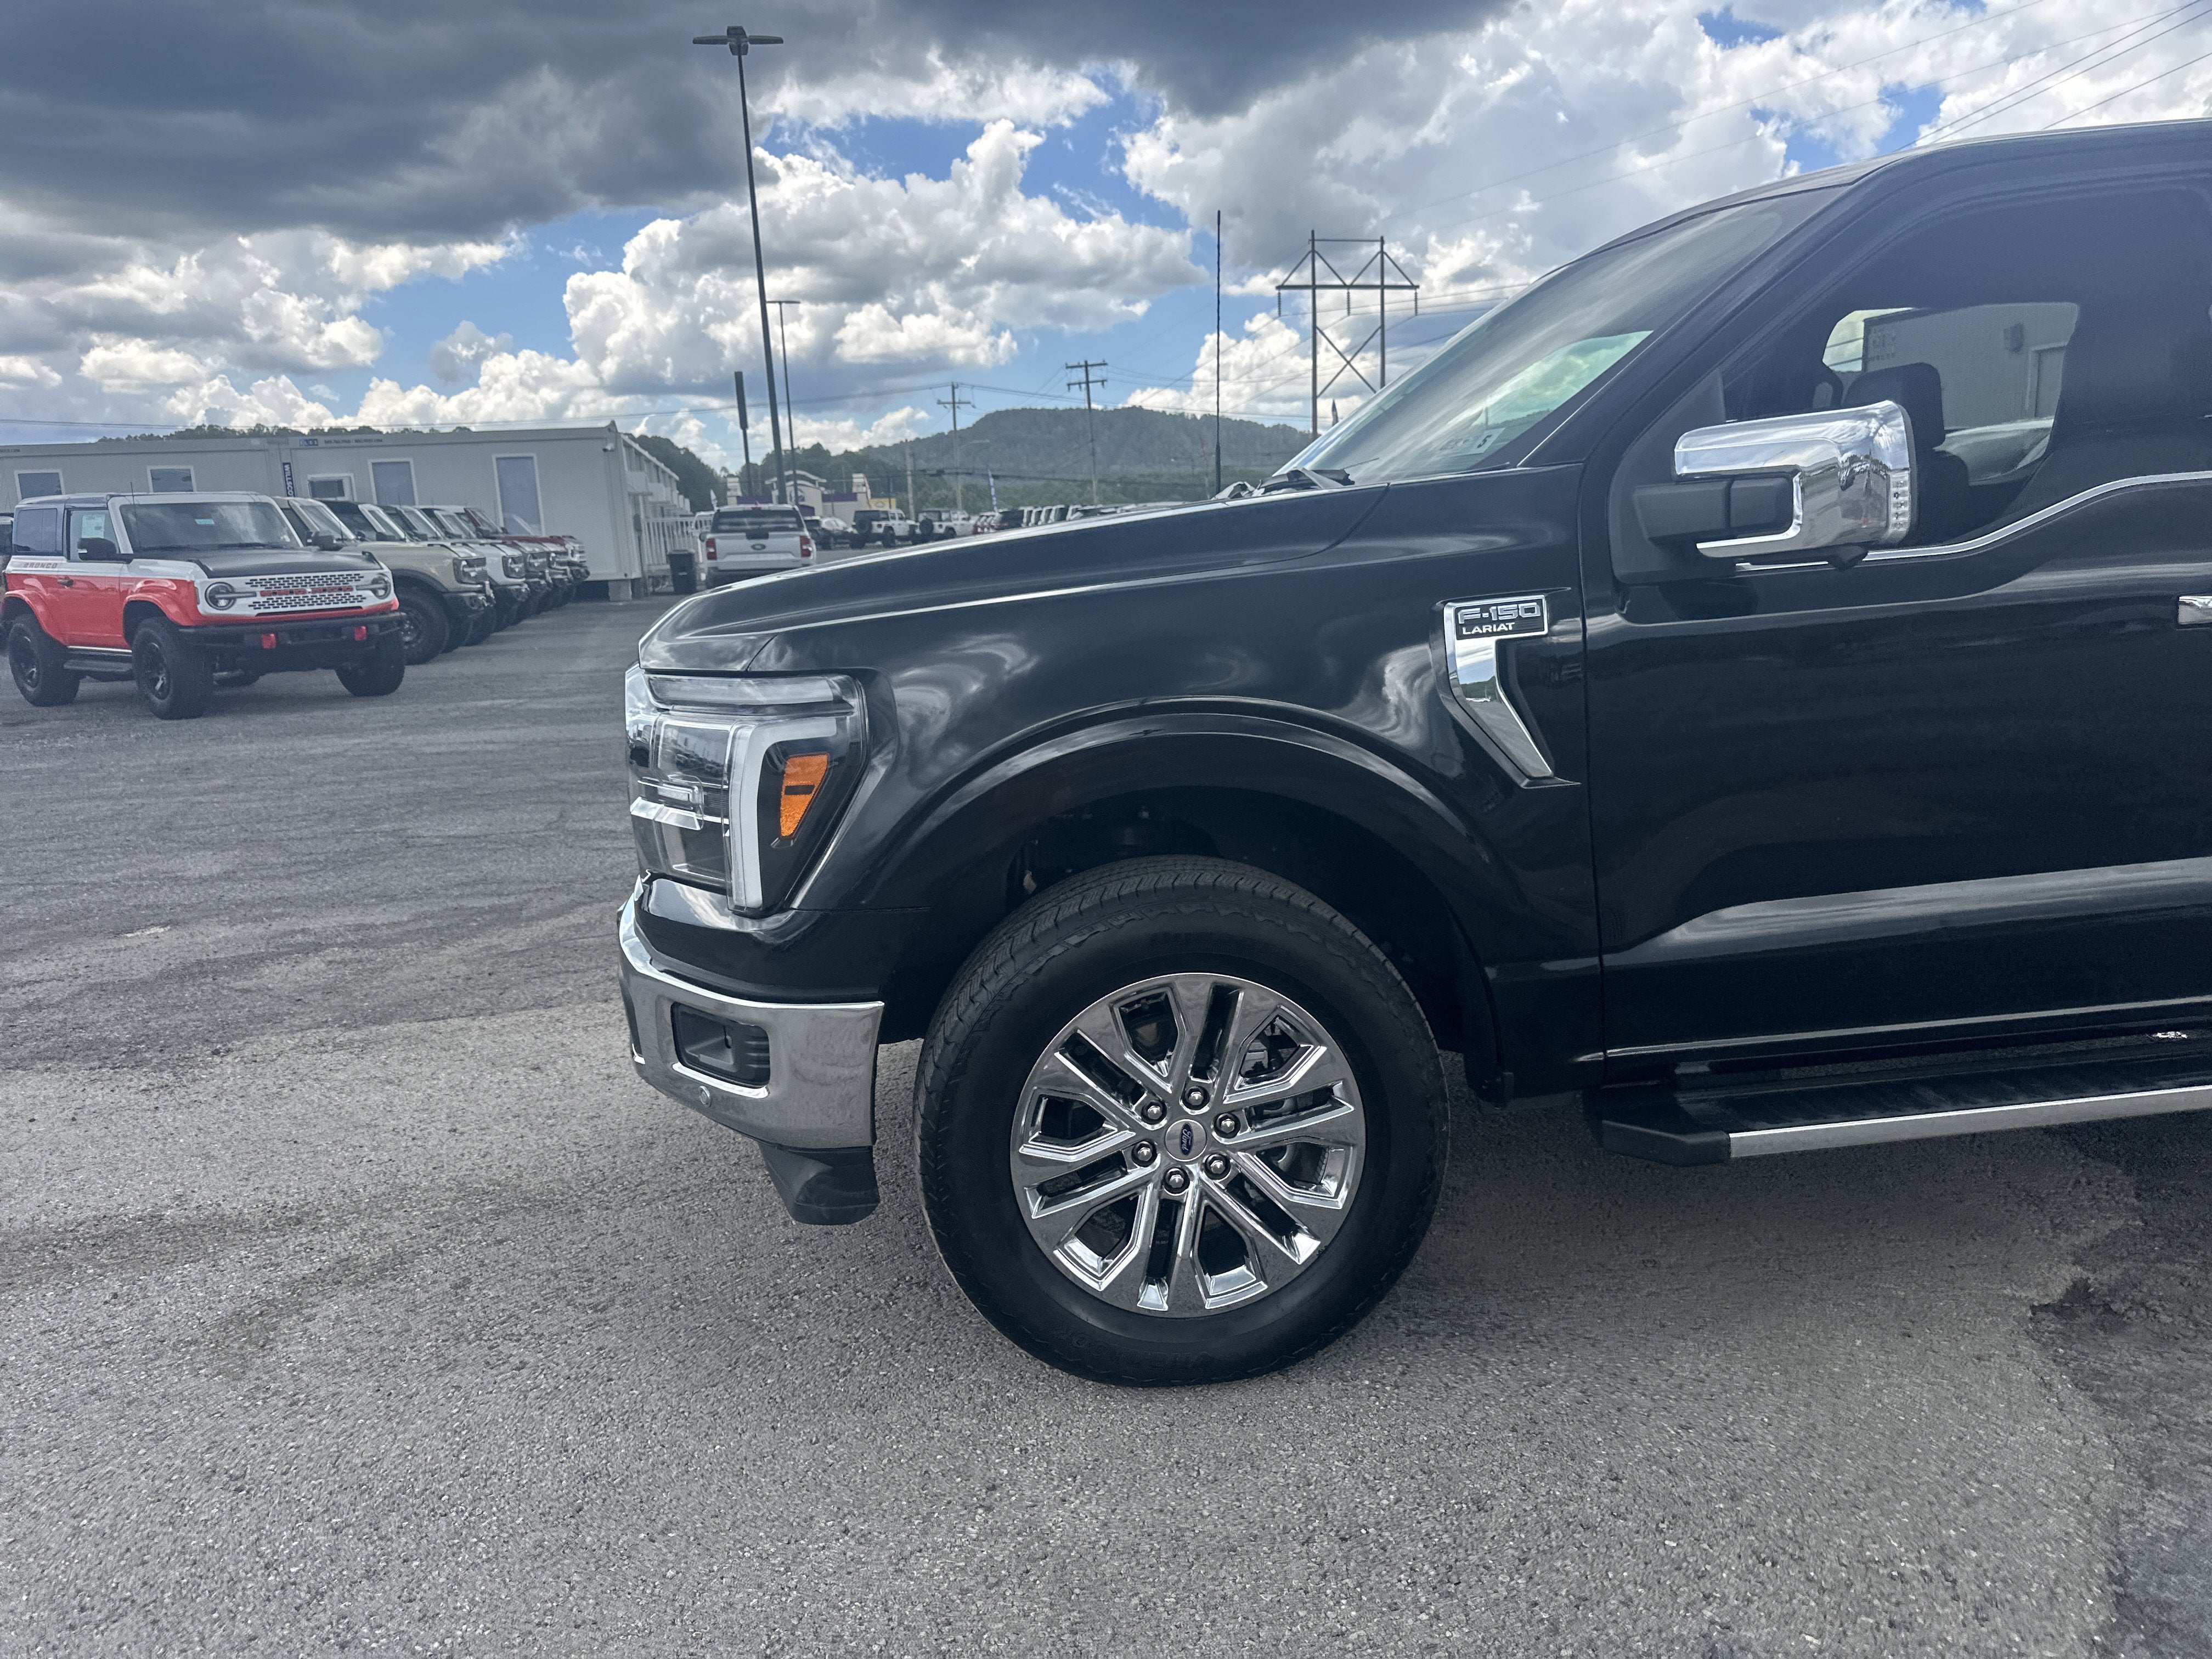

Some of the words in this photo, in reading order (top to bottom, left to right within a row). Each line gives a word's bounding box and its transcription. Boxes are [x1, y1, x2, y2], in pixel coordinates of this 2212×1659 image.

[284, 464, 294, 496] WILLSCO
[1457, 602, 1541, 624] F-150
[1462, 622, 1515, 635] LARIAT
[1181, 1128, 1192, 1151] Ford
